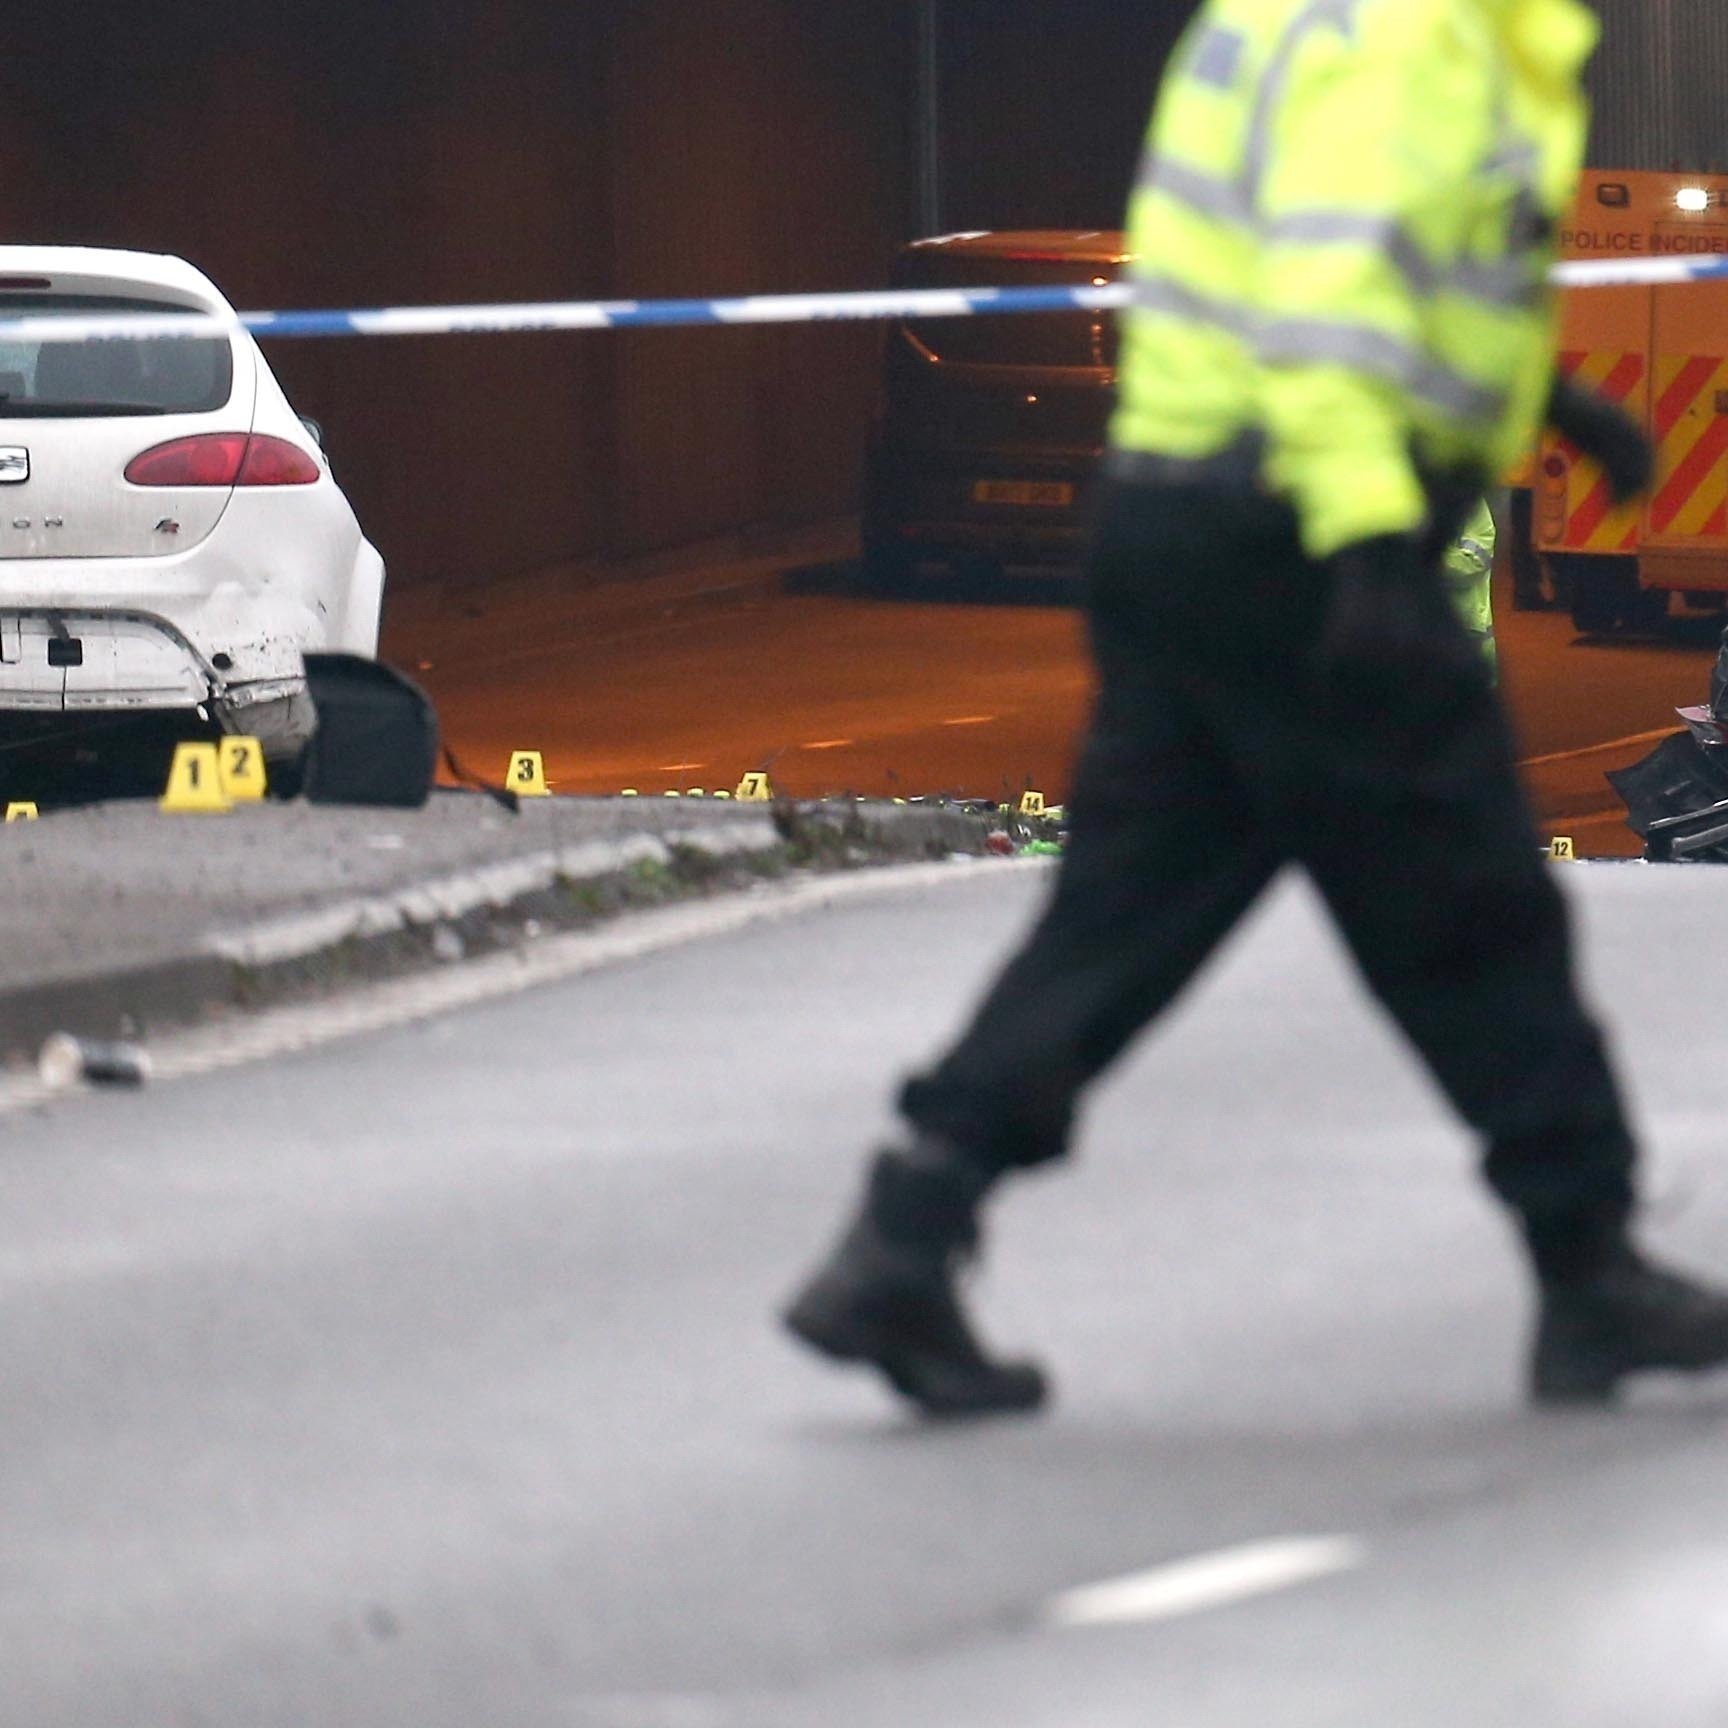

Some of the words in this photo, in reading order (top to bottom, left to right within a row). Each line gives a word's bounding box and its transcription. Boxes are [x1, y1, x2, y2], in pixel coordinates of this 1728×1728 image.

[1559, 229, 1641, 252] POLICE
[188, 756, 201, 789] 1
[231, 747, 250, 776] 2
[517, 757, 534, 782] 3
[747, 778, 759, 796] 7
[1554, 841, 1569, 857] 12
